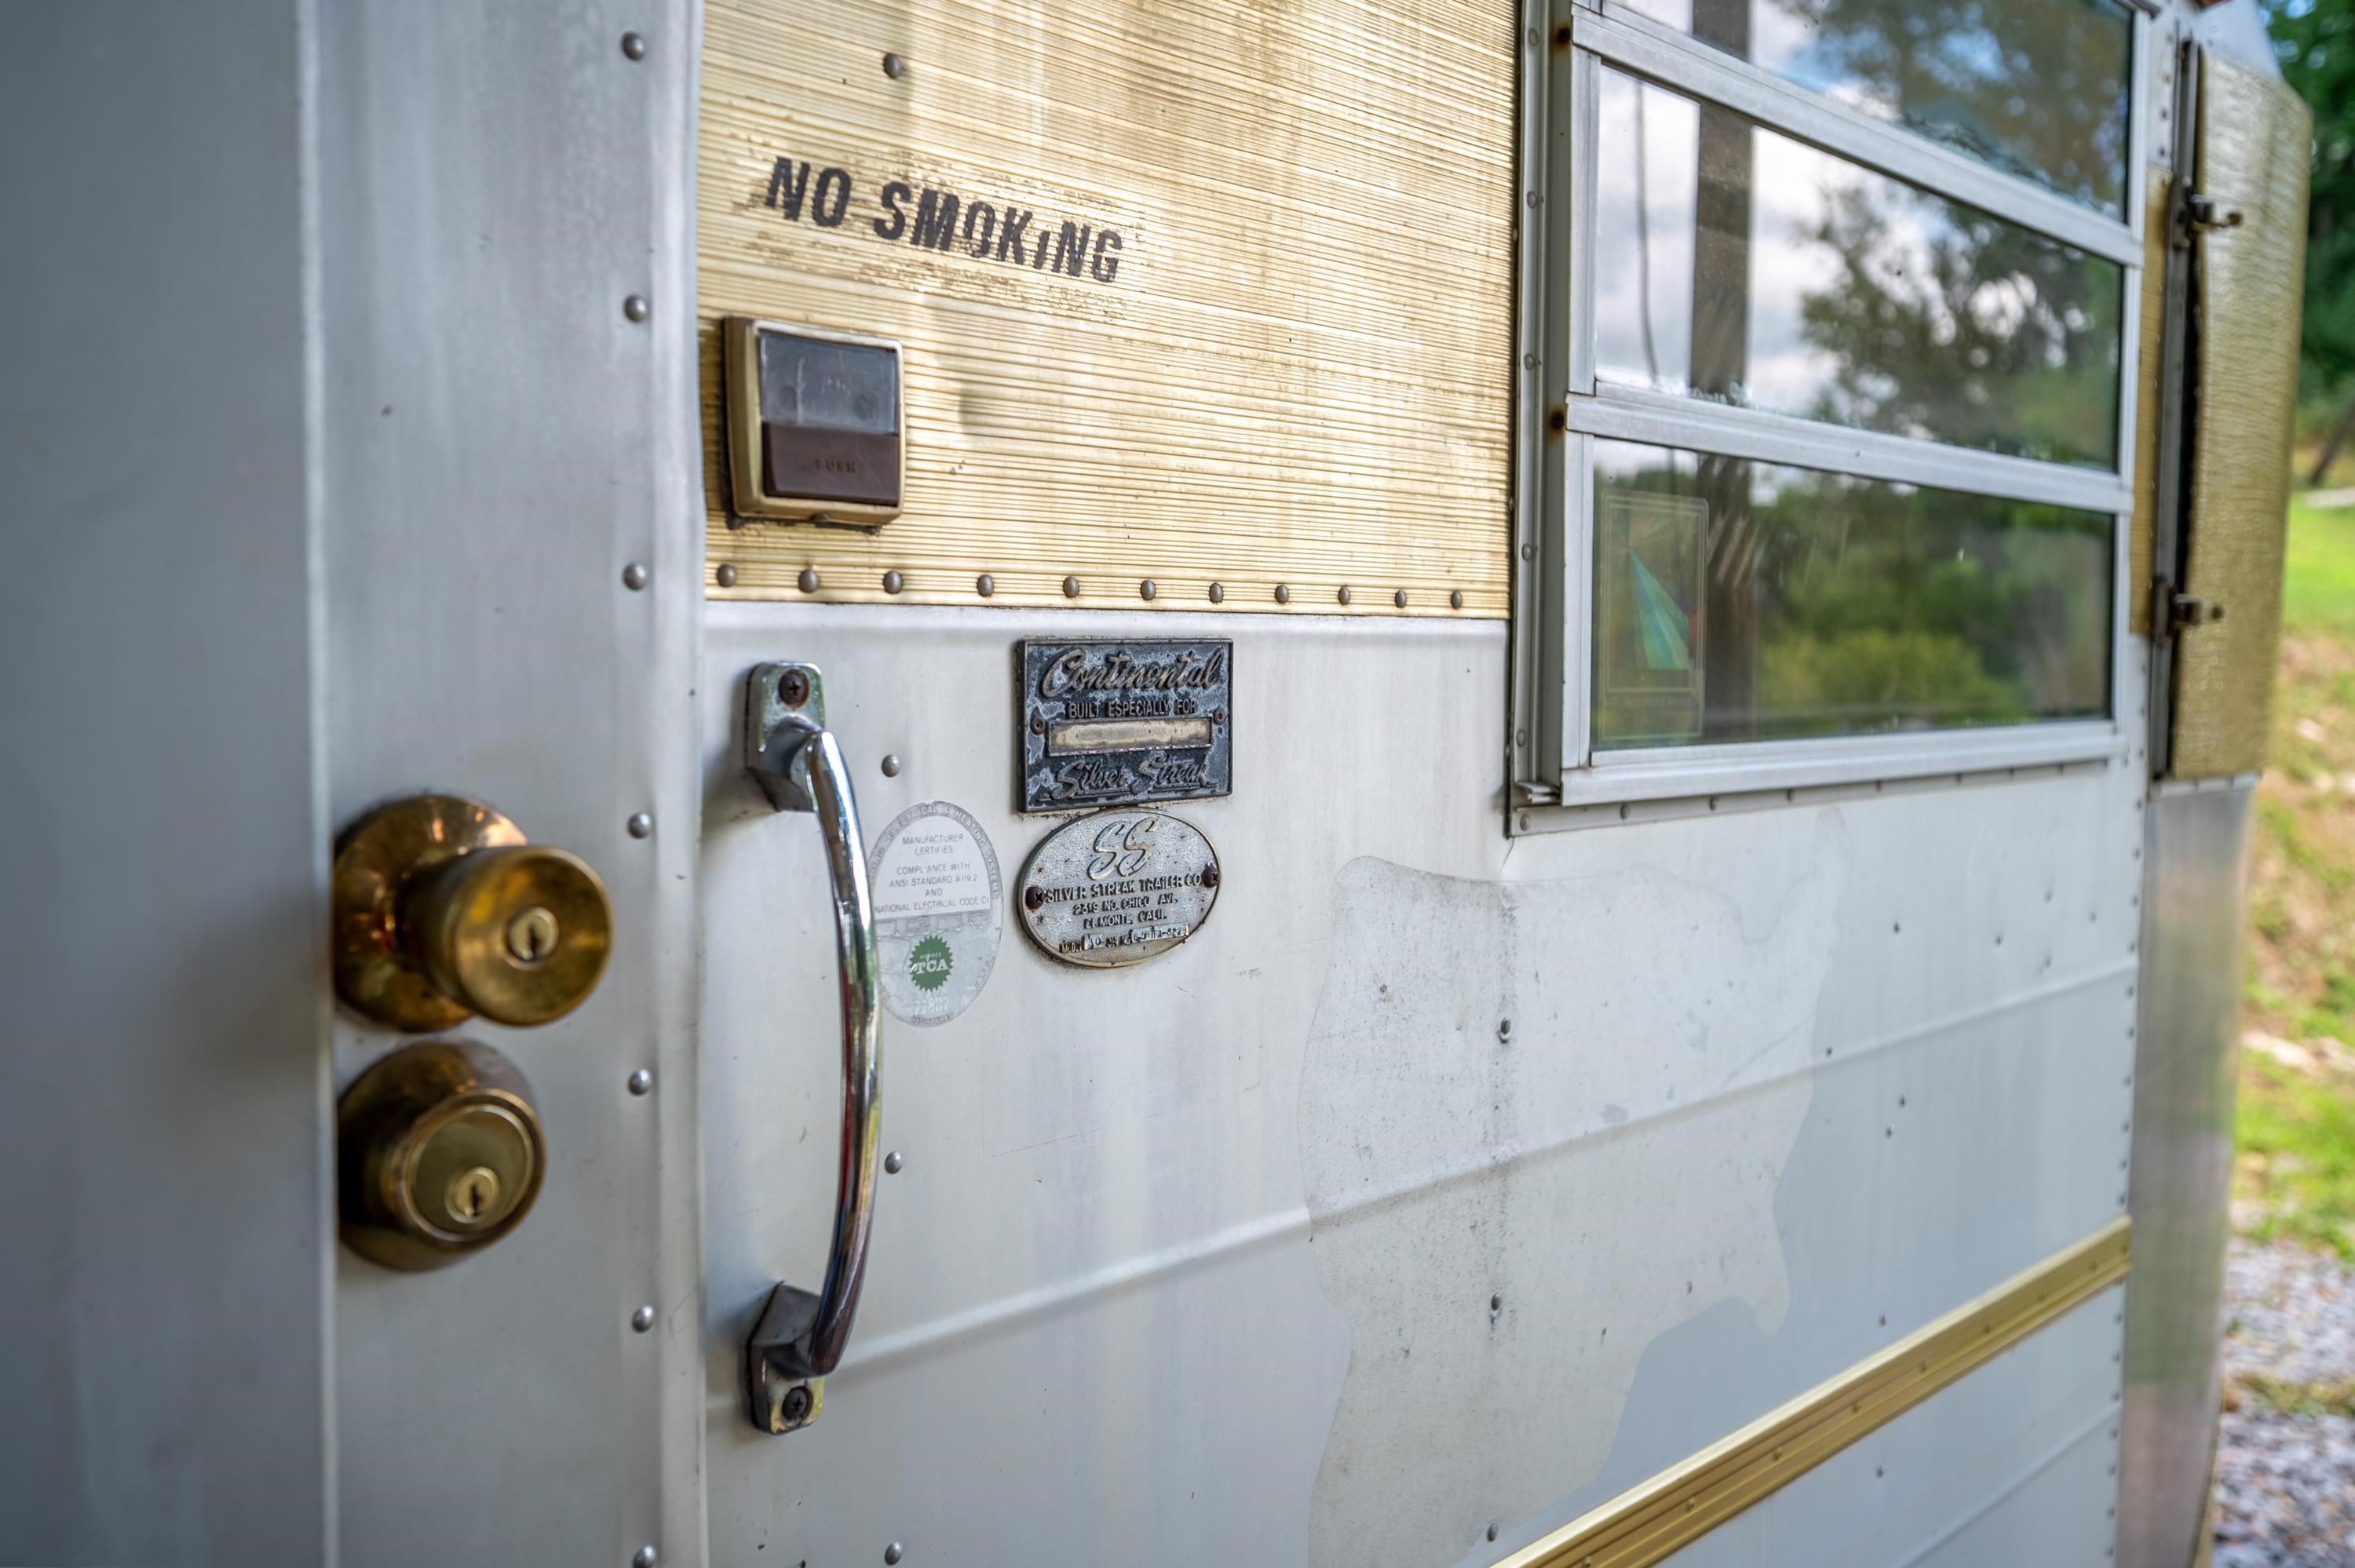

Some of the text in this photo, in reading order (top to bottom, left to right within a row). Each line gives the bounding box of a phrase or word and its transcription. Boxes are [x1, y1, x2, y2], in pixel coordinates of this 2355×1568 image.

[766, 156, 1123, 283] NO SMOKING
[1042, 646, 1224, 698] Continental
[1068, 698, 1196, 718] BUILT ESPECIALLY FOR
[1050, 758, 1129, 800] Silver
[902, 833, 964, 845] MANUFACTURER
[1087, 816, 1158, 880] SS
[955, 808, 987, 848] HEATING
[984, 849, 1001, 900] SYSTEMS
[896, 862, 970, 876] COMPLANCE WITH
[889, 878, 908, 888] ANSI
[911, 874, 953, 887] STANDARD
[1046, 886, 1086, 903] SILVER
[1091, 880, 1135, 897] STREAK
[1139, 874, 1182, 892] TRAILER
[925, 887, 943, 897] AND
[874, 903, 911, 913] NATIONAL
[958, 896, 978, 906] CODE
[1120, 896, 1150, 910] CHICO
[914, 958, 950, 975] TCA
